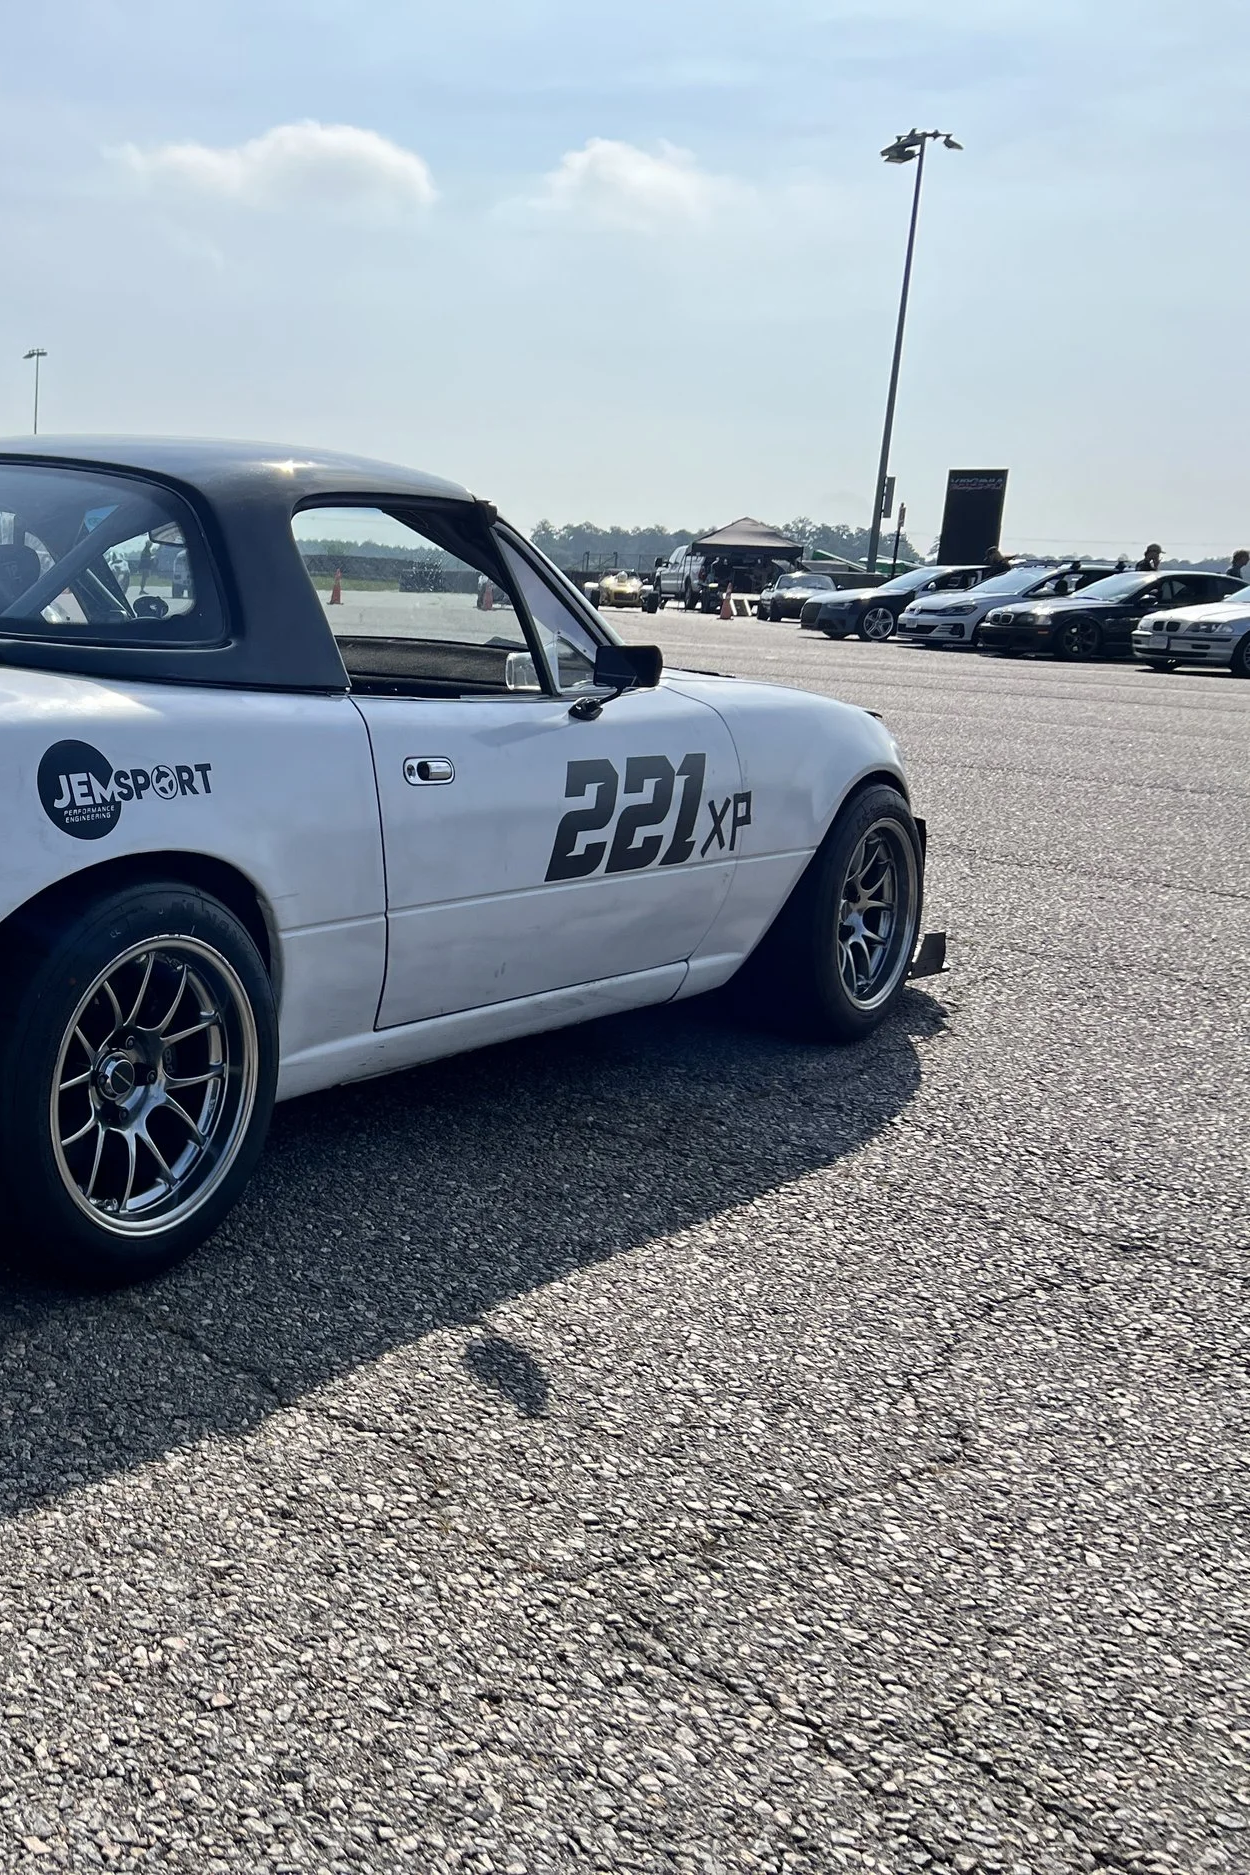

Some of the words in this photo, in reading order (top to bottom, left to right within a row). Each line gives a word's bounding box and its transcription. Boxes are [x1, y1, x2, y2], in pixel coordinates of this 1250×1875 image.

[63, 804, 115, 817] PERFORMANCE
[544, 752, 706, 882] 221
[700, 790, 752, 859] XP
[65, 812, 111, 824] ENGINEERING
